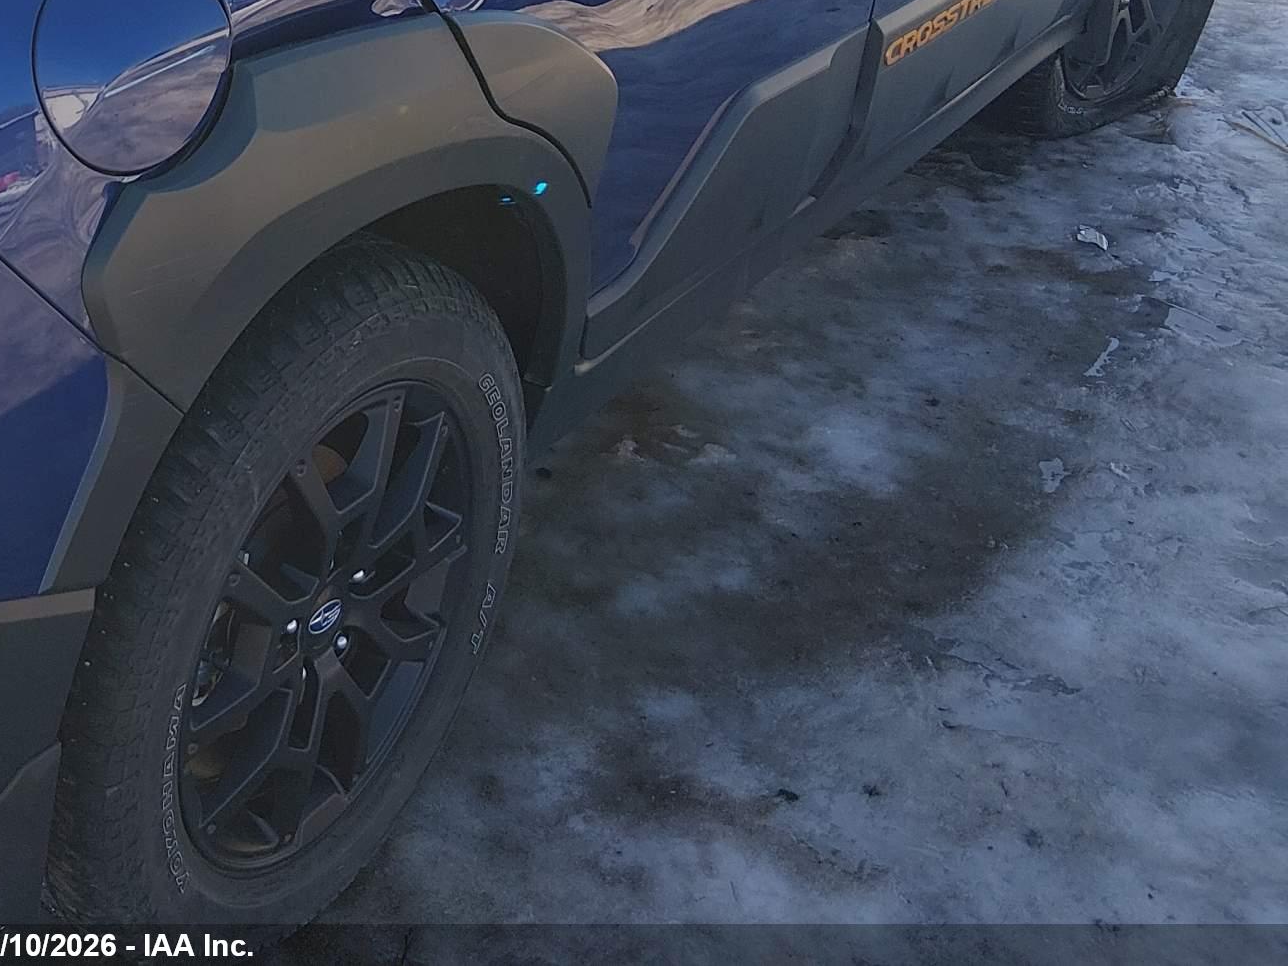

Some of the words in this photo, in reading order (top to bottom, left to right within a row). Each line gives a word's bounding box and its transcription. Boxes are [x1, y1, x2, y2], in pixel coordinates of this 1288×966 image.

[478, 372, 514, 556] GEOLANDAR
[470, 582, 497, 656] A/T
[162, 683, 191, 895] YOKOHAMA
